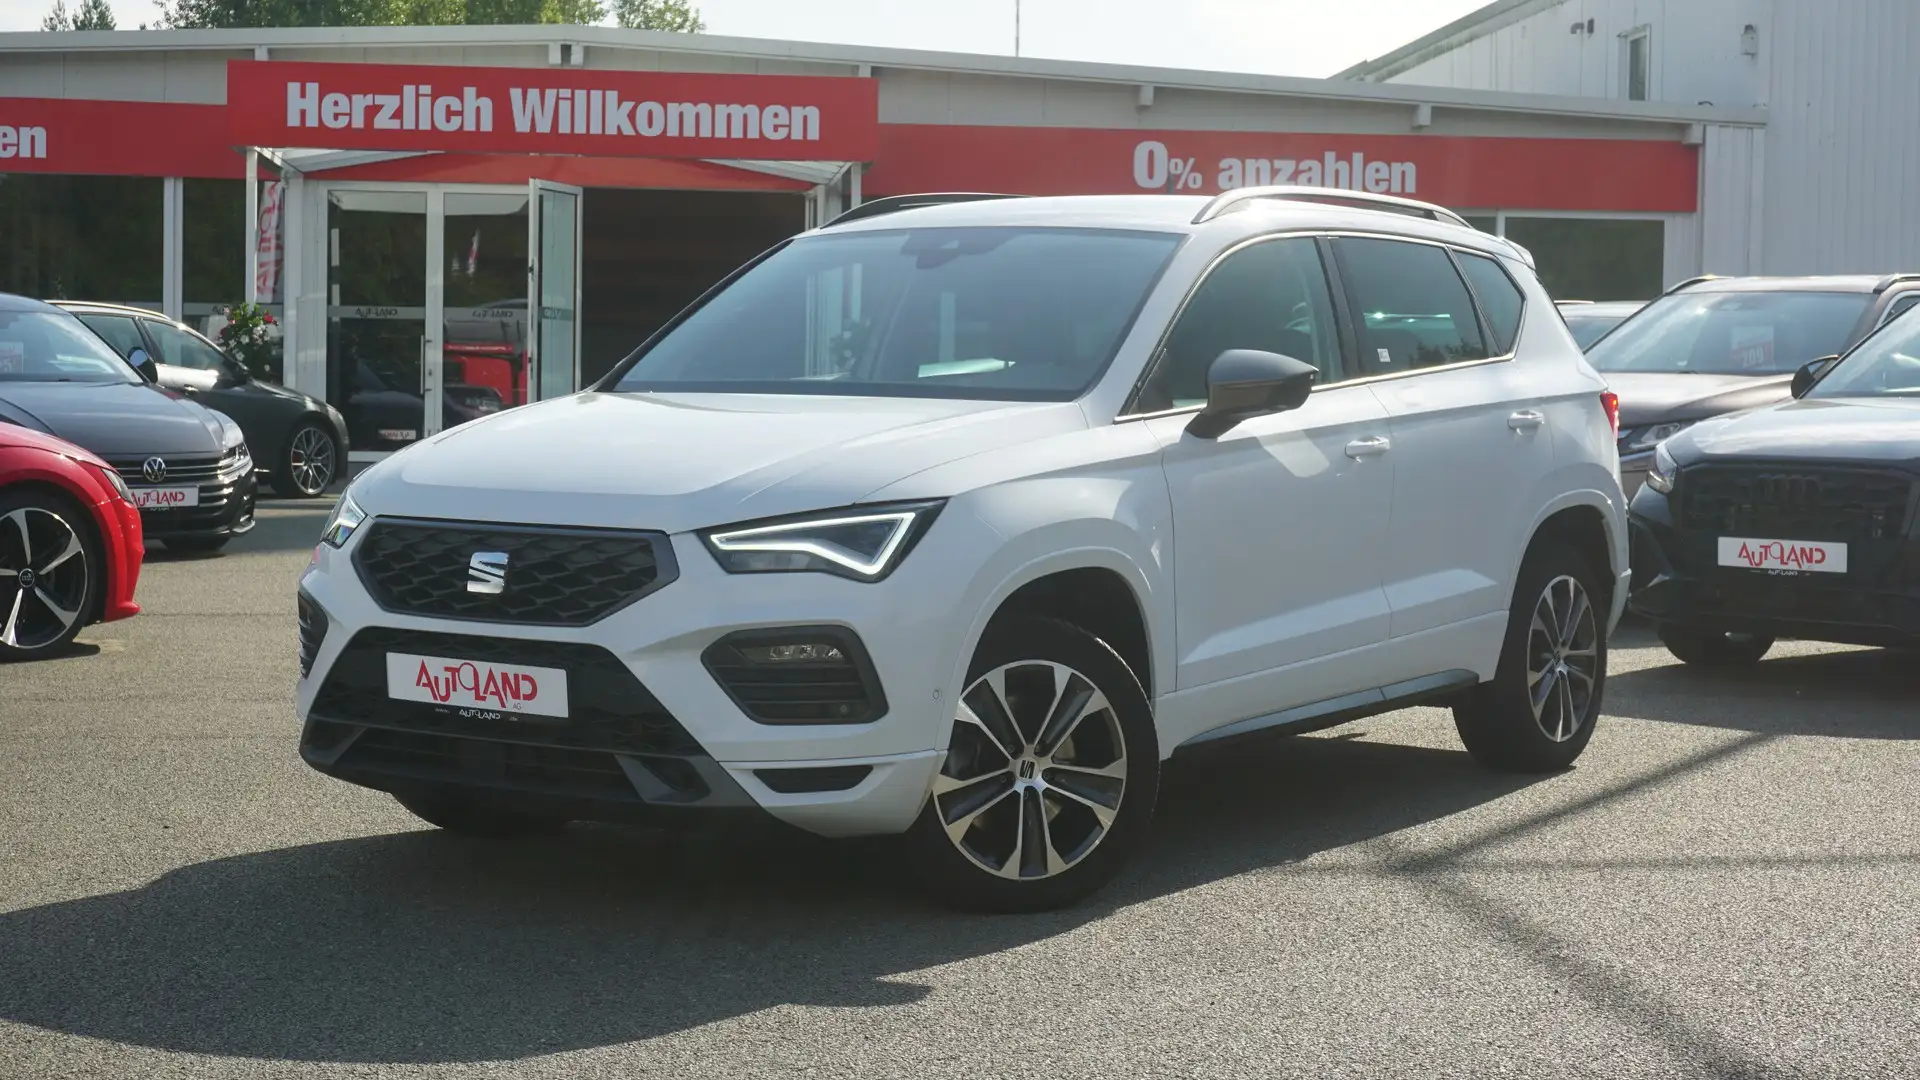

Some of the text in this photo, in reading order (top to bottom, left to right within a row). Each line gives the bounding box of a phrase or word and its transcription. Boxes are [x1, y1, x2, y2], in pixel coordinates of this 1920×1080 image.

[287, 82, 820, 140] Herzlich Willkommen
[1133, 140, 1417, 193] 0% anzahlen
[1738, 541, 1826, 569] AUTOLAND
[416, 659, 538, 708] AUTOLAND
[459, 709, 501, 720] AUTOLAND
